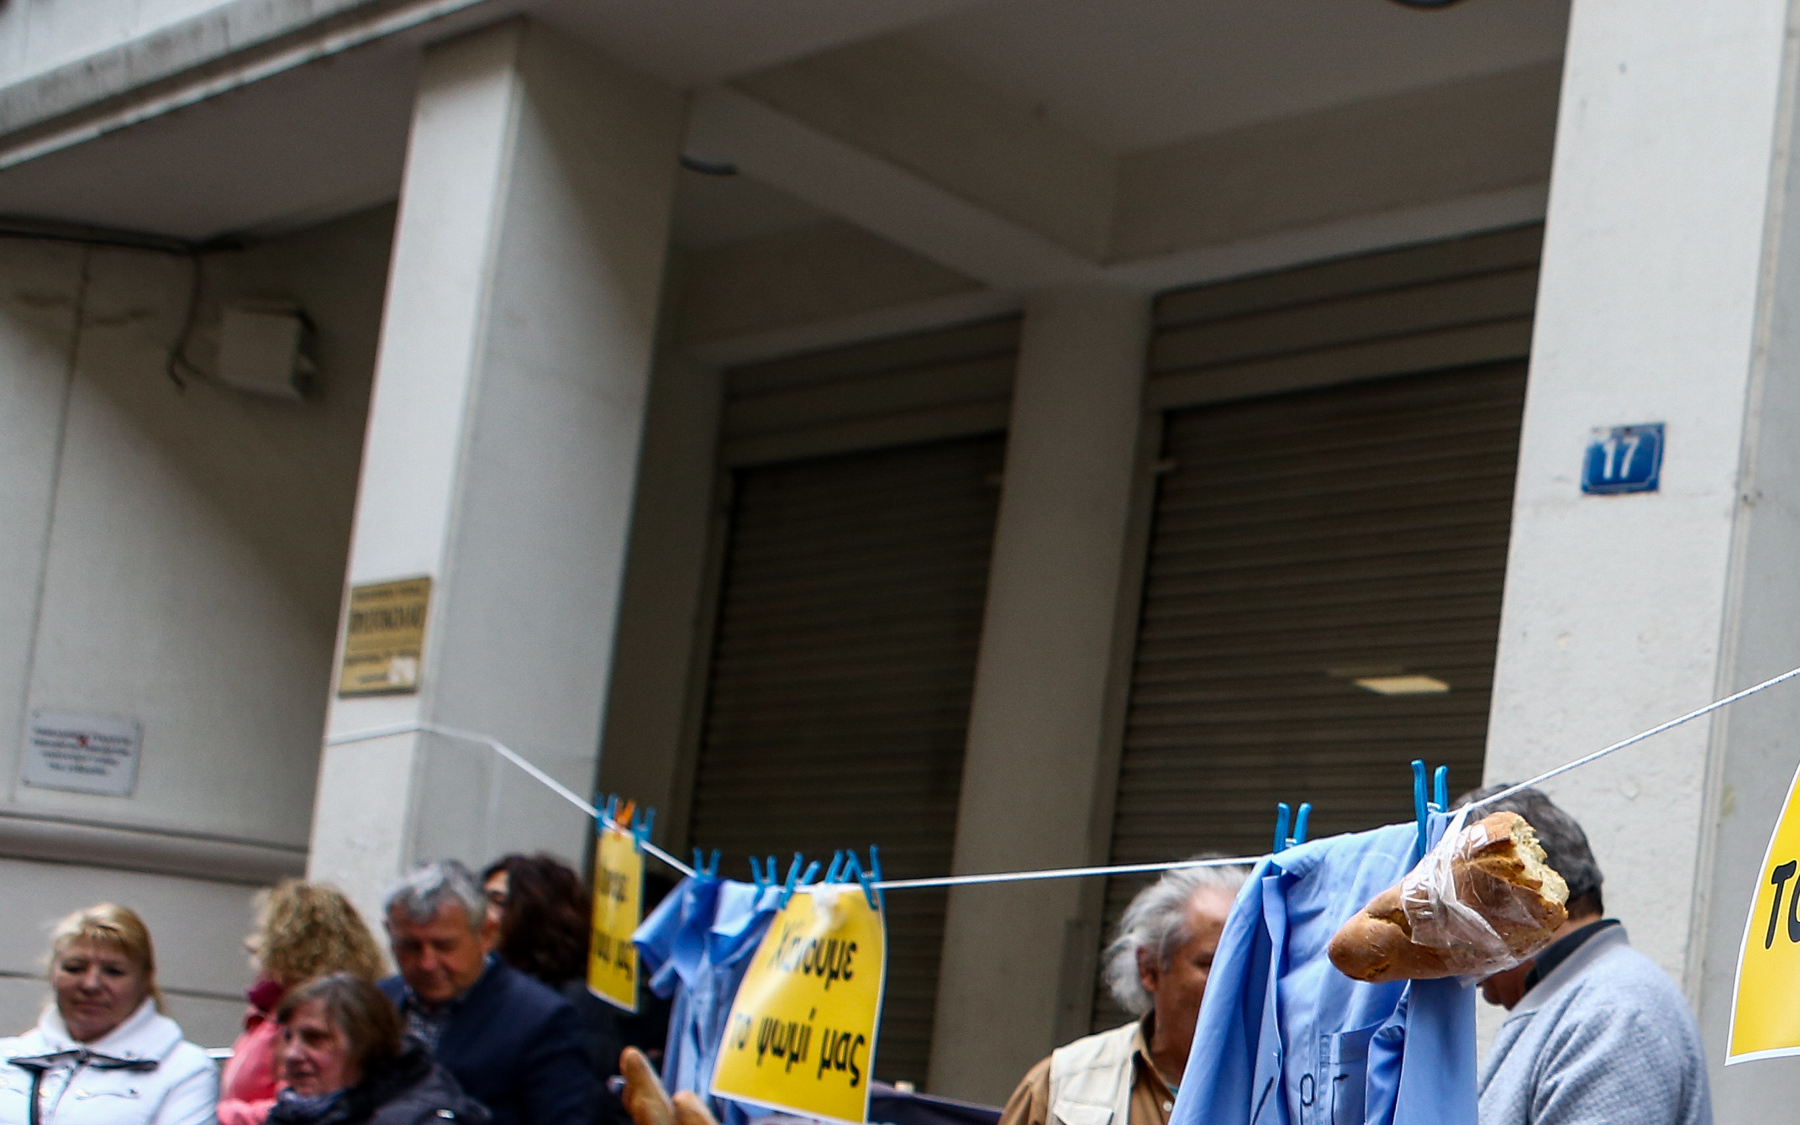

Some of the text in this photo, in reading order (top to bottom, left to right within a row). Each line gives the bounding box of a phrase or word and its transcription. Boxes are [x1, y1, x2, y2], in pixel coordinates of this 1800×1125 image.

[1602, 438, 1640, 479] 17
[757, 1007, 816, 1073] ψωμί
[817, 1028, 865, 1088] μας
